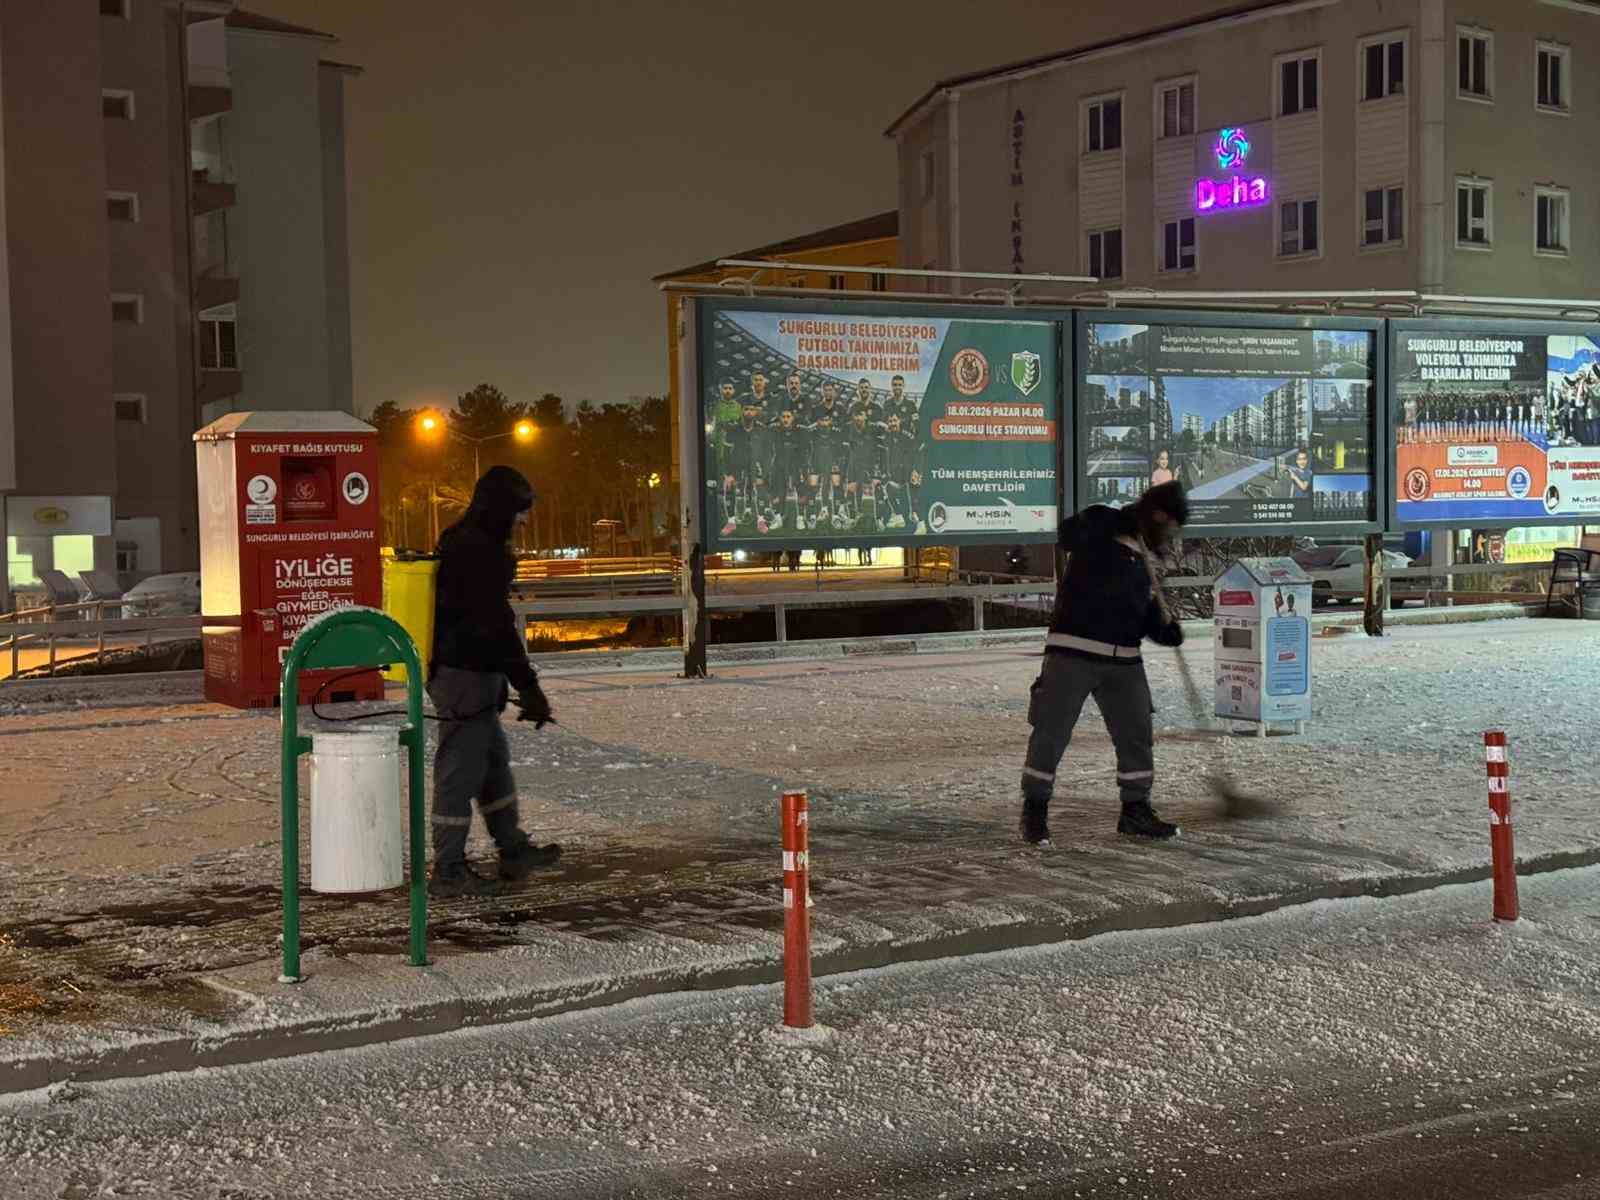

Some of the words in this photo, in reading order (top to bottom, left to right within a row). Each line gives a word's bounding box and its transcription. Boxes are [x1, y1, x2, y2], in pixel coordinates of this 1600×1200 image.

[1197, 176, 1265, 209] Deha
[778, 319, 847, 336] SUNGURLU
[850, 321, 937, 339] BELEDİYESPOR
[798, 337, 845, 353] FUTBOL
[848, 339, 920, 355] TAKIMIMIZA
[1408, 338, 1458, 352] SUNGURLU
[1459, 337, 1524, 353] BELEDİYESPOR
[871, 354, 920, 372] DİLERİM
[1415, 353, 1461, 366] VOLEYBOL
[1463, 353, 1517, 367] TAKIMIMIZA
[1421, 367, 1473, 383] BAŞARILAR
[993, 407, 1021, 417] PAZAR
[938, 424, 985, 435] SUNGURLU
[1004, 425, 1048, 436] STADYUMU
[250, 443, 290, 453] KIYAFET
[324, 443, 363, 453] KUTUSU
[931, 467, 955, 479] TÜM
[957, 468, 1056, 481] HEMŞEHRİLERİMİZ
[962, 481, 1025, 493] DAVETLİDİR
[246, 533, 287, 543] SUNGURLU
[276, 577, 353, 590] DÖNÜŞECEKSE
[301, 590, 329, 601] EĞER
